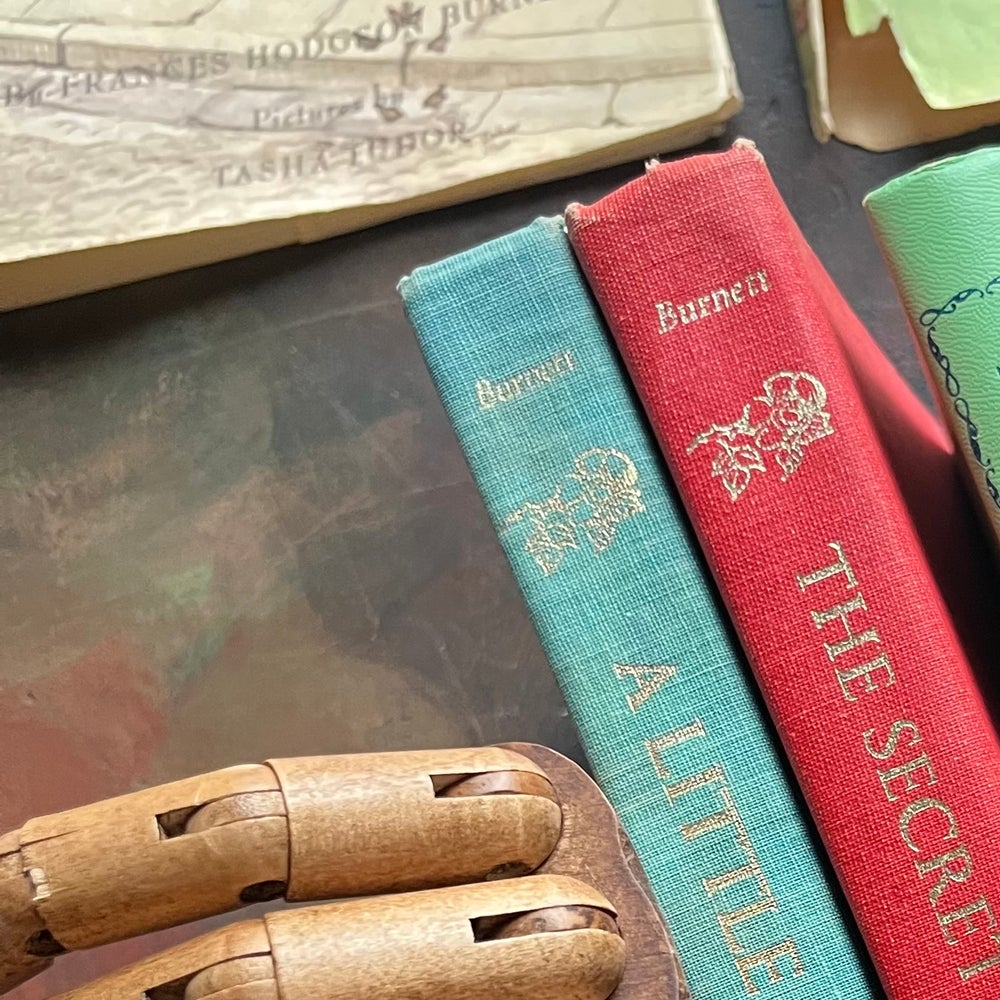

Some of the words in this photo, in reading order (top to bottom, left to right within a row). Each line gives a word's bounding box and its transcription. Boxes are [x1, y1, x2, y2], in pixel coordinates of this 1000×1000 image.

[61, 52, 229, 98] FRANCES
[252, 95, 364, 130] Pictures
[213, 142, 328, 189] TASHA
[340, 119, 472, 167] TUDOR
[655, 268, 771, 335] Burnett
[475, 350, 577, 411] Burnett
[796, 541, 897, 703] THE
[613, 660, 678, 713] A
[644, 717, 803, 996] LITTLE
